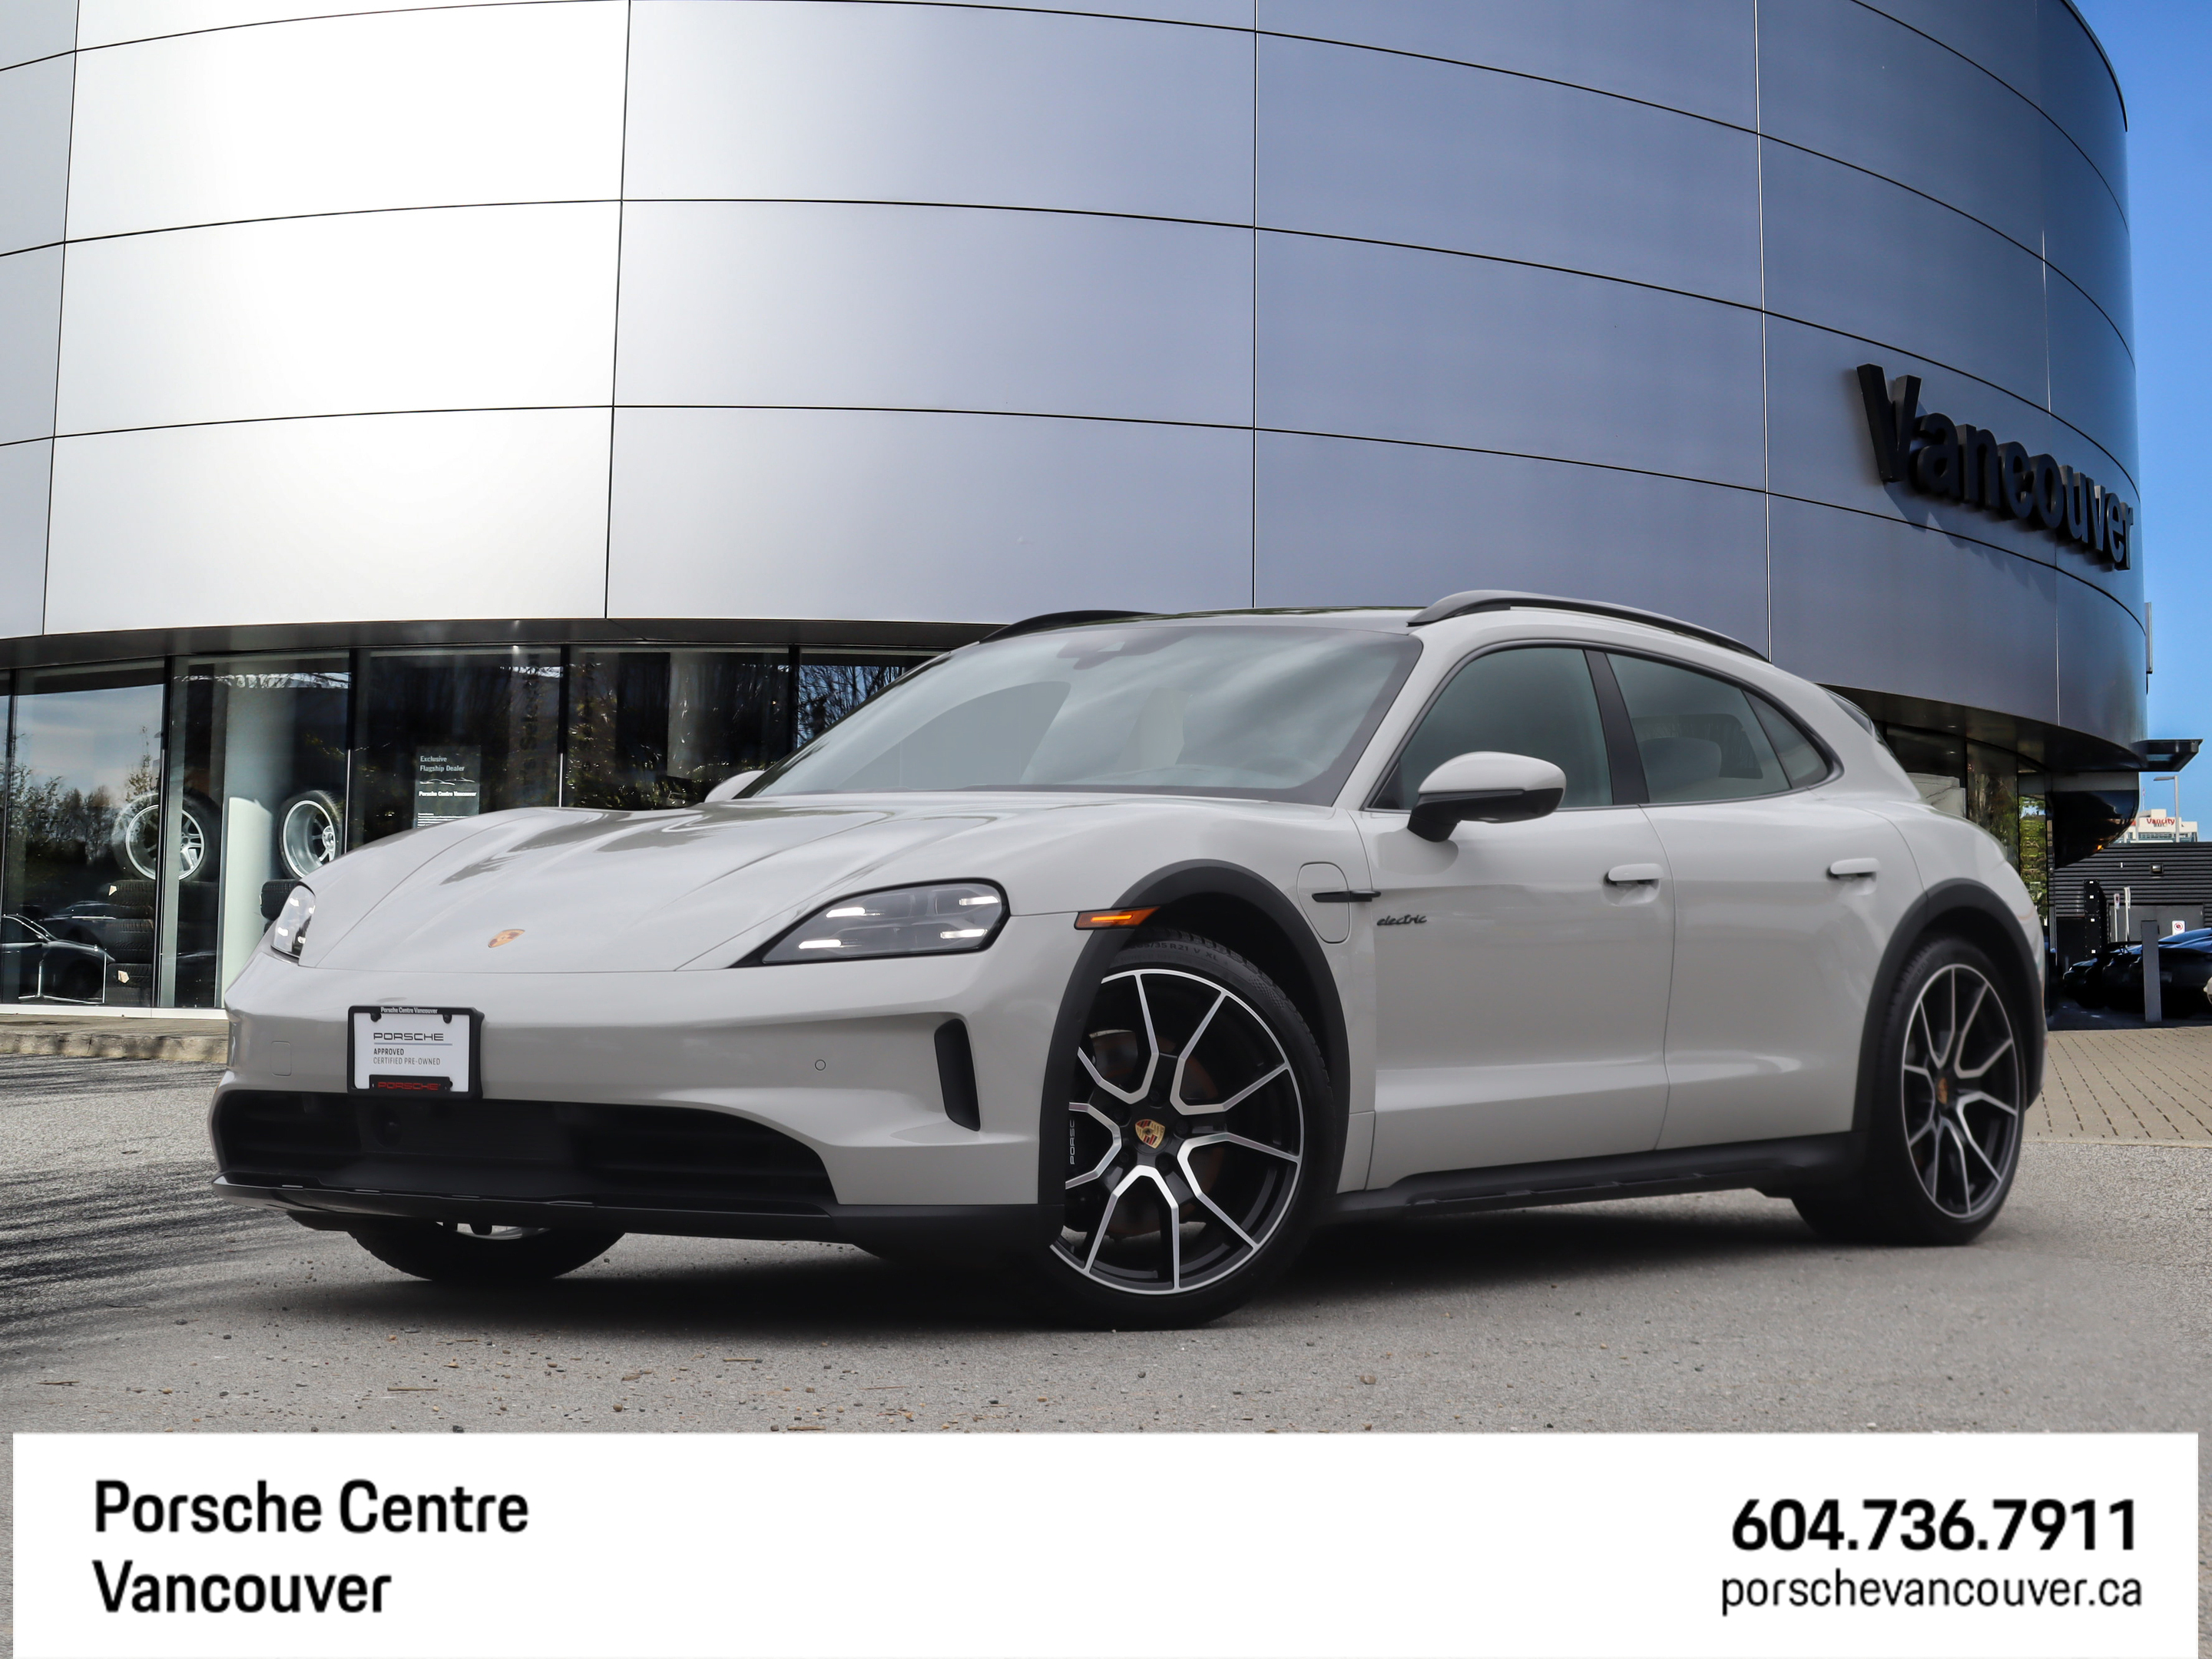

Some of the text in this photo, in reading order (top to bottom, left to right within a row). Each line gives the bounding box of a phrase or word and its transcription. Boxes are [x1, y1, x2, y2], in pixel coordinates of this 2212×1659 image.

[1856, 363, 2134, 571] Vancouver
[1376, 914, 1427, 926] electric
[1206, 952, 1218, 961] XL
[377, 1082, 439, 1091] PORSCHE
